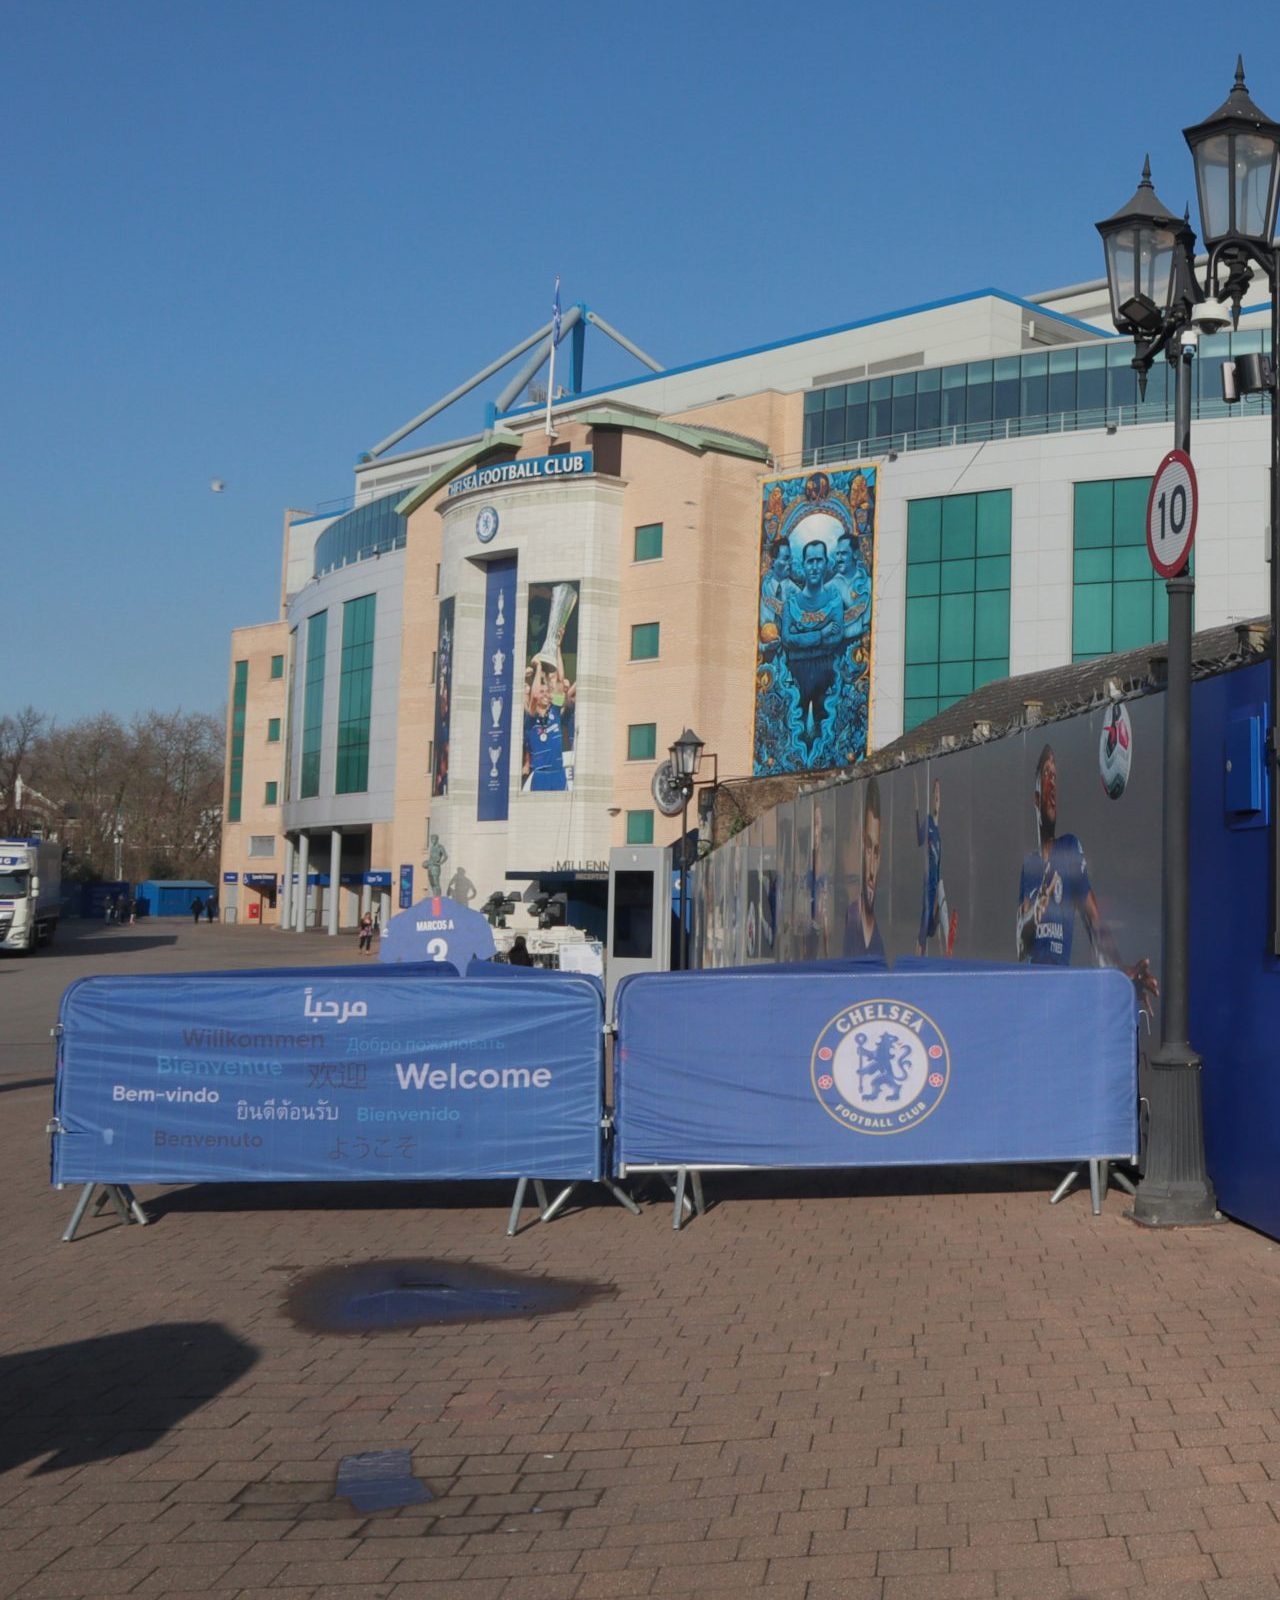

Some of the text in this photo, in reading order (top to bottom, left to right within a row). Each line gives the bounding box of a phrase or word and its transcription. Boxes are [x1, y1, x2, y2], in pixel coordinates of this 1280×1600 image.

[479, 461, 541, 487] FOOTBALL
[544, 456, 583, 475] CLUB
[1158, 484, 1187, 540] 10
[416, 920, 455, 932] MARCOS A
[835, 1004, 925, 1034] CHELSEA
[182, 1029, 325, 1049] Willkommen
[346, 1037, 505, 1054] Добро пожаловать
[156, 1055, 283, 1075] Bienvenue
[307, 1062, 368, 1090] 欢迎
[395, 1063, 552, 1090] Welcome
[113, 1085, 220, 1103] Bem-vindo
[236, 1098, 339, 1121] ยินดีต้อนรับ
[356, 1106, 461, 1122] Bienvenido
[835, 1101, 926, 1128] FOOTBALL CLUB
[154, 1130, 263, 1148] Benvenuto
[328, 1136, 418, 1160] ようこそ
